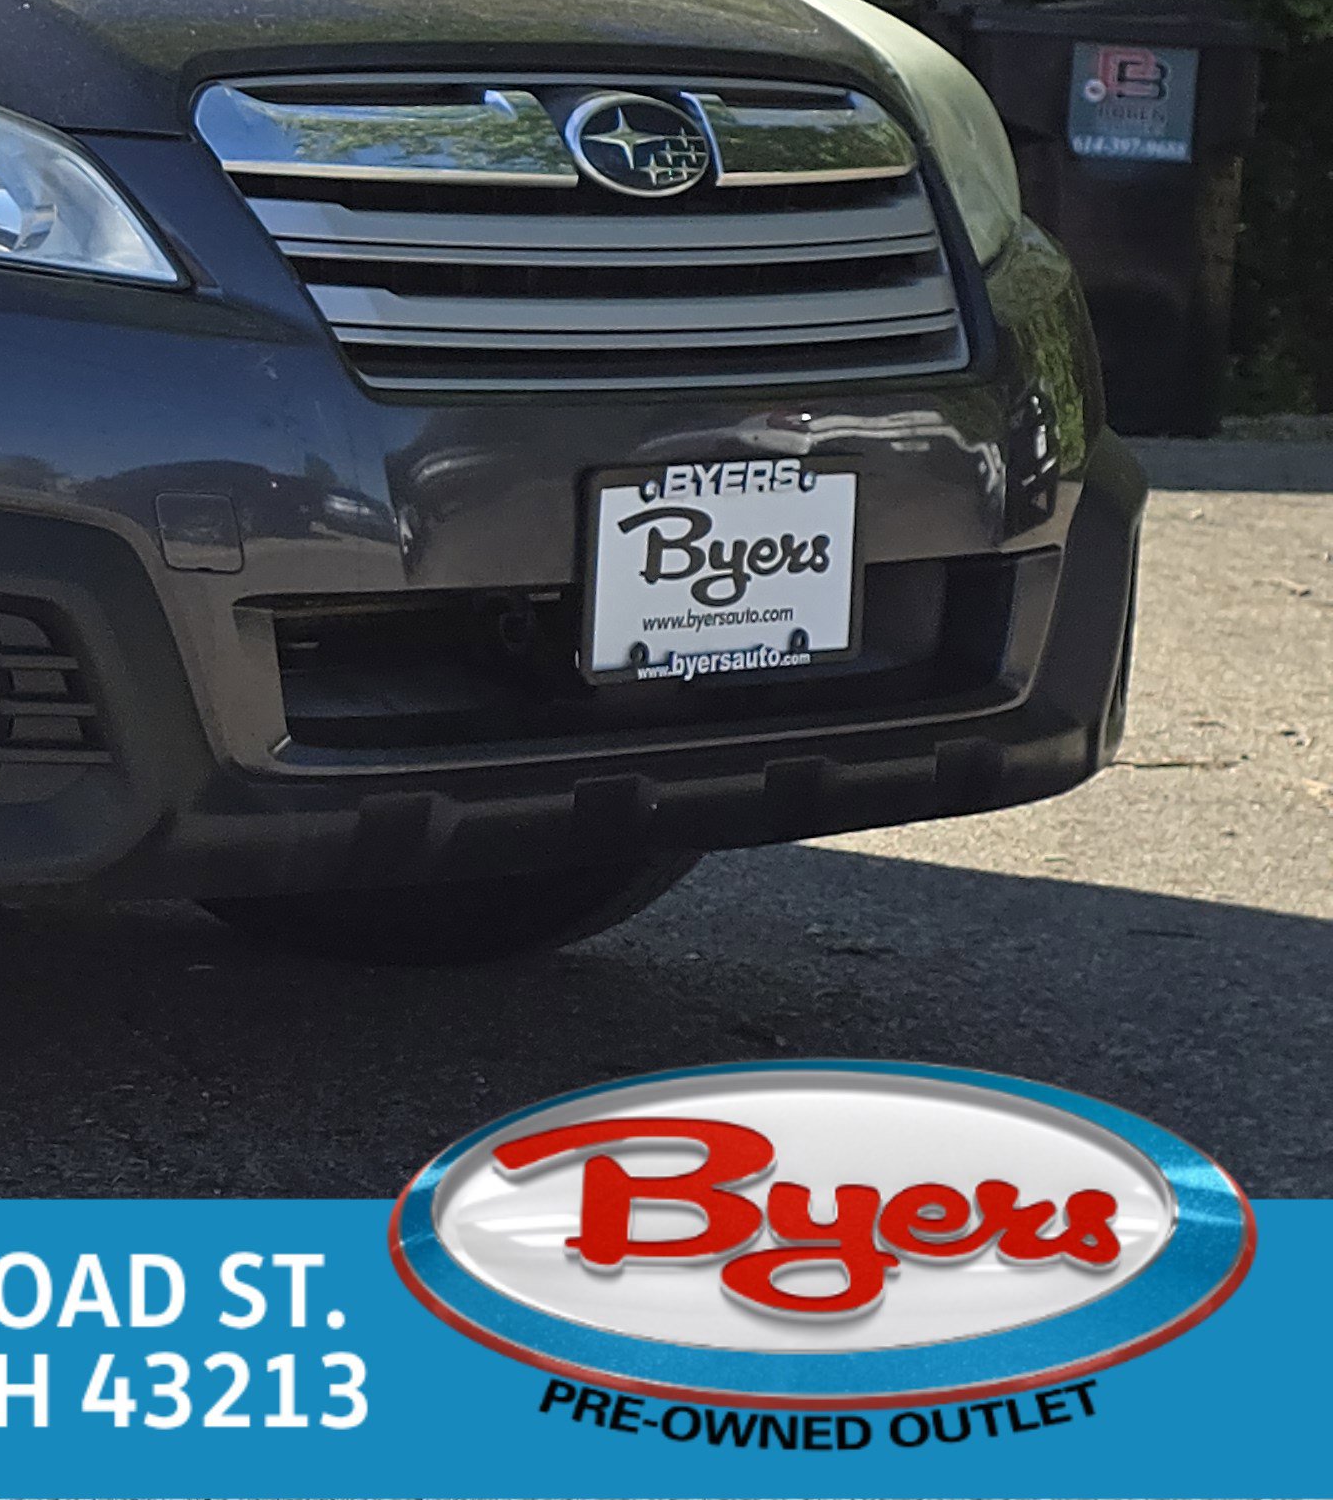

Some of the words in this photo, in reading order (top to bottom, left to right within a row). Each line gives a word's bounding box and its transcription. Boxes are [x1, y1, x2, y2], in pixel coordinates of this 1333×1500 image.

[663, 458, 801, 499] BYERS
[617, 505, 831, 607] Byers
[641, 607, 794, 632] www.byersauto.com
[636, 649, 811, 681] www.byersauto.com
